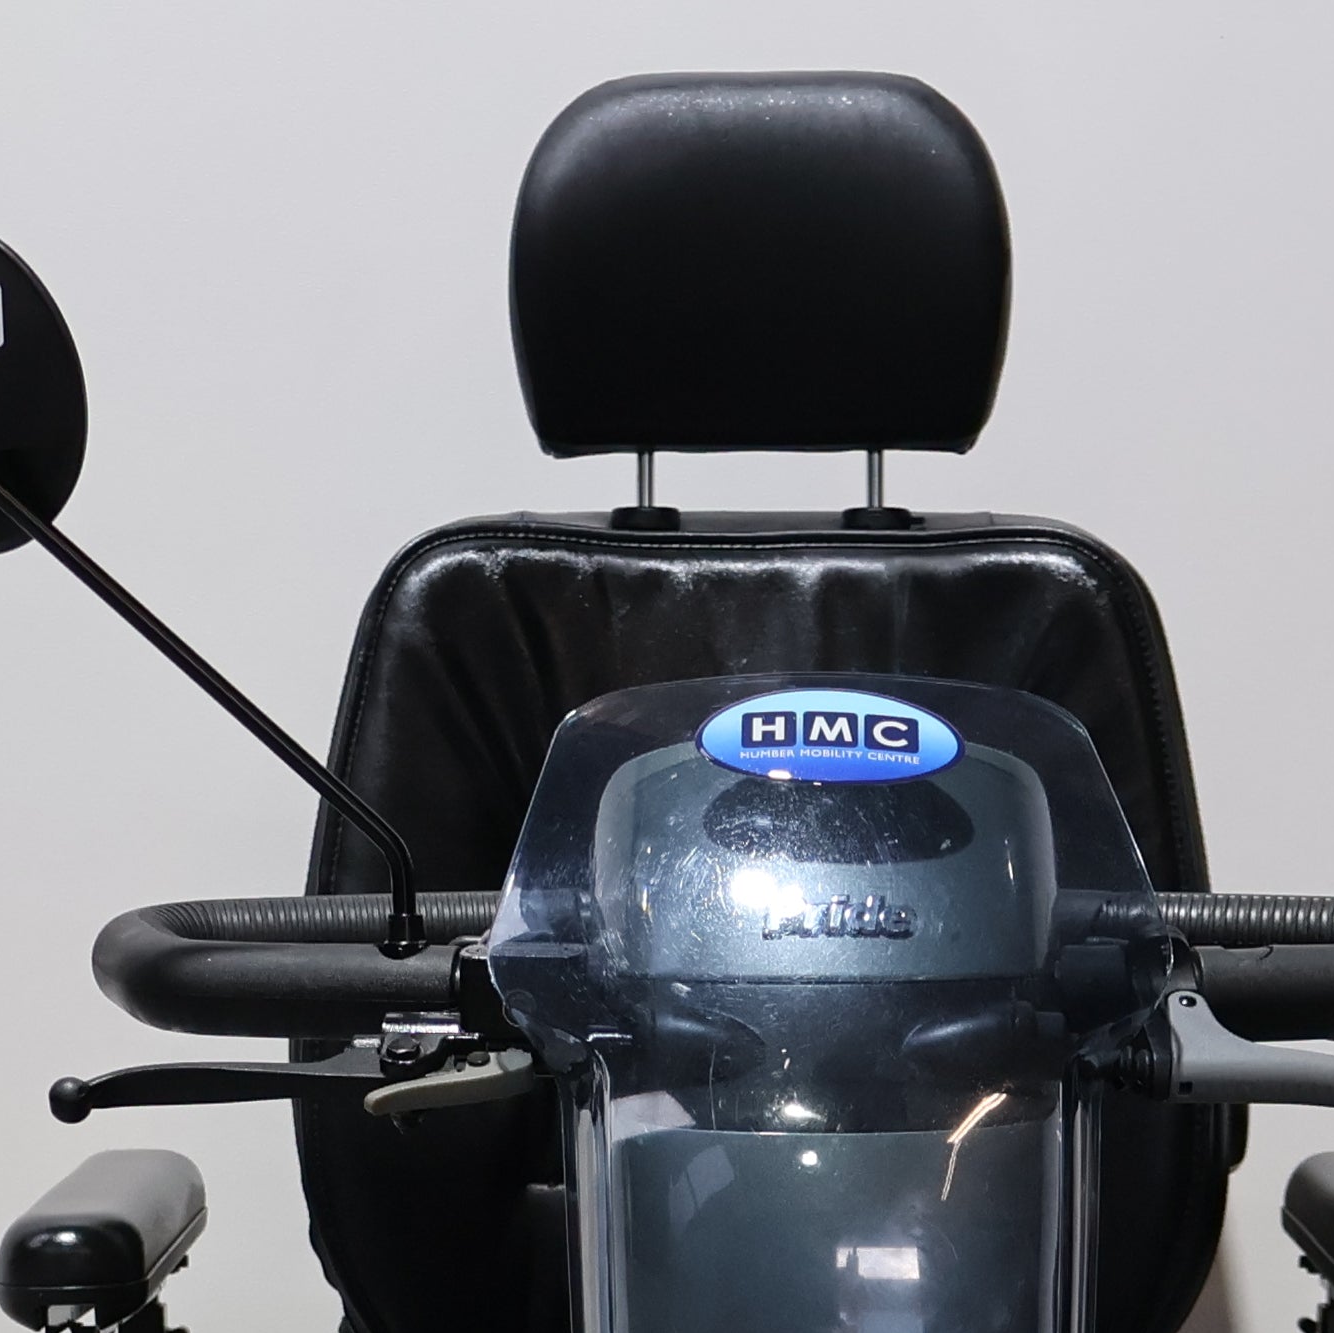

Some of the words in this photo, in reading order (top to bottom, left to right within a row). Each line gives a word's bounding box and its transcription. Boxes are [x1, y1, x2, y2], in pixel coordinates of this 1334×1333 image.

[751, 715, 909, 749] HMC
[739, 750, 795, 760] HUMBER
[799, 748, 863, 760] MOBILITY
[867, 751, 921, 765] CENTRE
